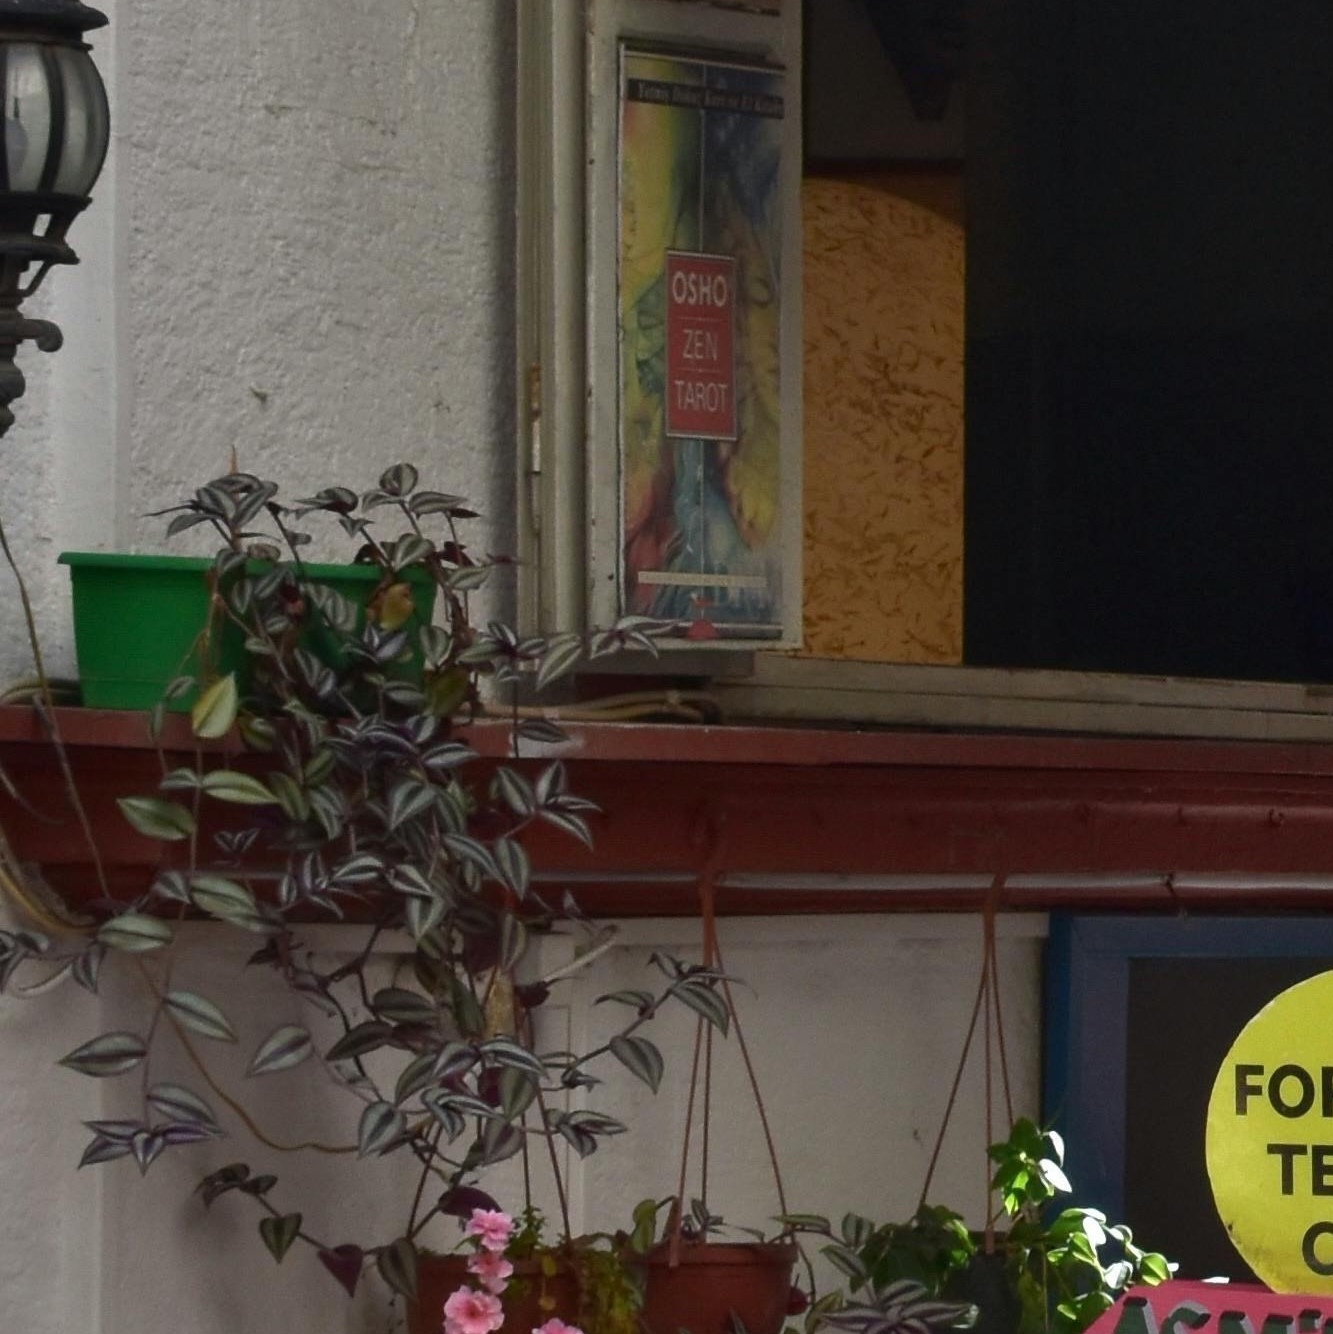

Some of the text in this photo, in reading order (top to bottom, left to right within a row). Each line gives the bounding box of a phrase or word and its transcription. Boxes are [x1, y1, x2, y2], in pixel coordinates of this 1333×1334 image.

[672, 271, 727, 308] OSHO
[682, 328, 718, 361] ZEN
[674, 379, 728, 414] TAROT
